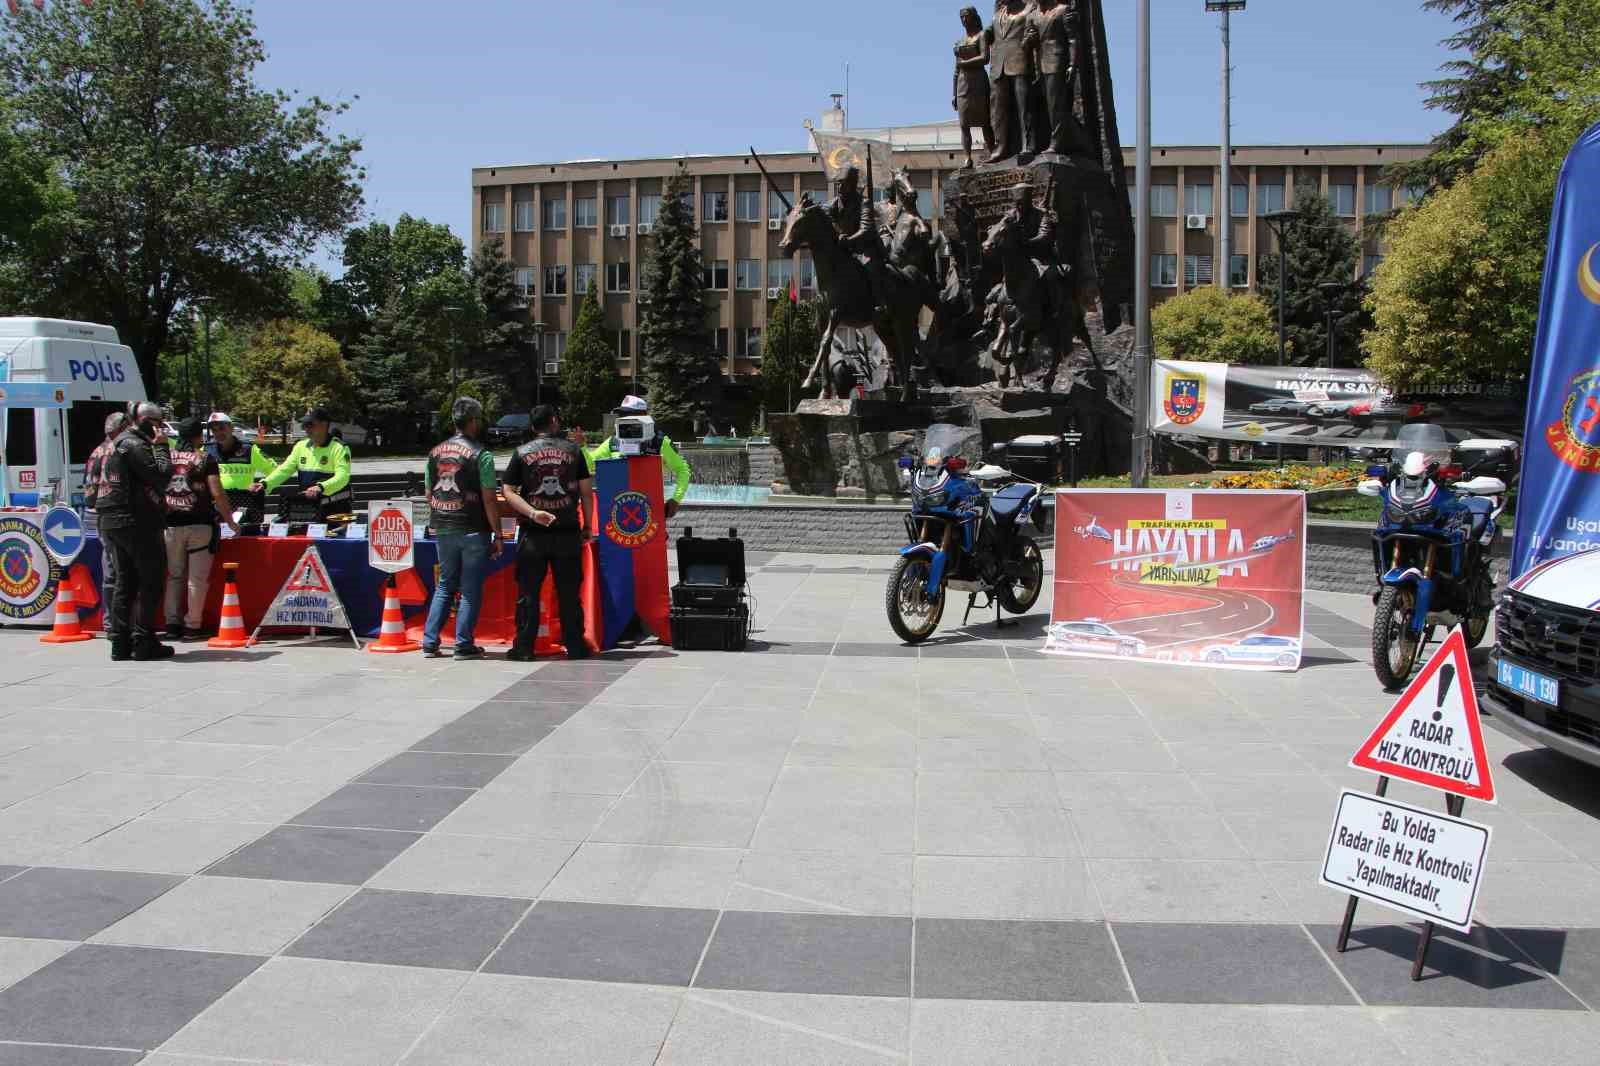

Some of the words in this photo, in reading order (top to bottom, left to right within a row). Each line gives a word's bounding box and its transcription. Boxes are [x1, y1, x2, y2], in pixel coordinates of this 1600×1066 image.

[69, 355, 125, 383] POLİS
[1275, 380, 1340, 393] HAYATA
[21, 472, 34, 482] 112
[378, 516, 406, 531] DUR
[1140, 521, 1172, 529] TRAFİK
[1174, 521, 1214, 529] HAFTASI
[372, 531, 409, 545] JANDARMA
[383, 546, 400, 561] STOP
[1111, 528, 1249, 577] HAYATLA
[1149, 564, 1212, 583] YARIŞILMAZ
[1409, 718, 1454, 746] RADAR
[1377, 739, 1401, 763] HIZ
[1402, 745, 1474, 780] KONTROLÜ
[1382, 811, 1399, 833] Bu
[1403, 815, 1437, 844] Yolda
[1338, 825, 1374, 853] Radar
[1374, 837, 1391, 859] ile
[1393, 842, 1414, 866] Hız
[1415, 848, 1473, 884] Kontrolü
